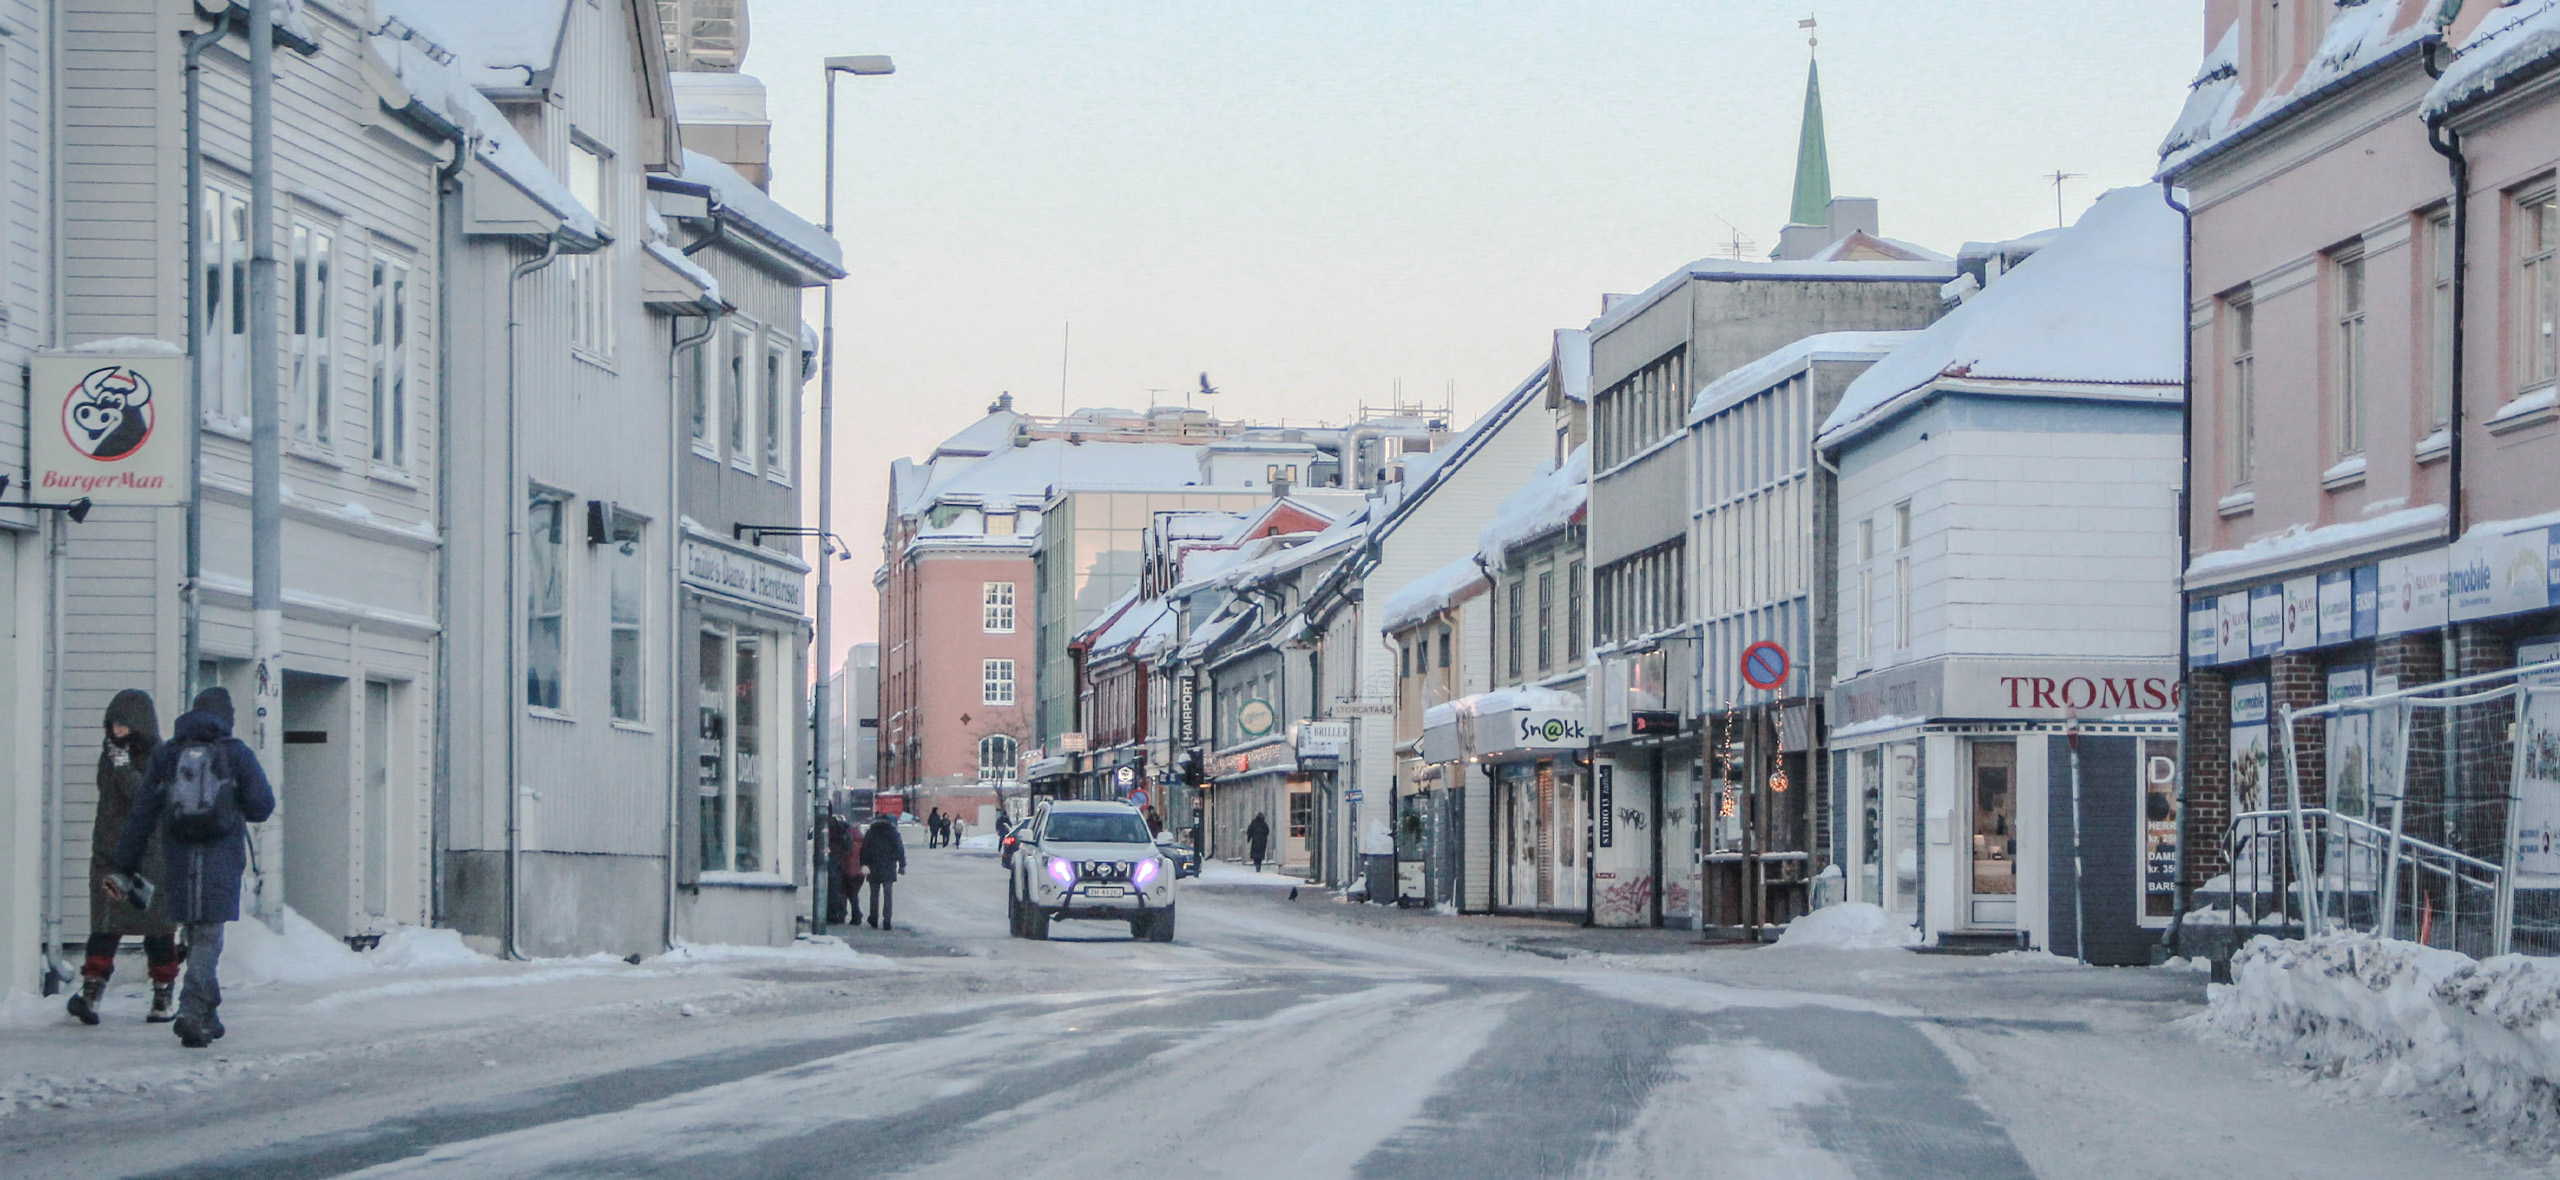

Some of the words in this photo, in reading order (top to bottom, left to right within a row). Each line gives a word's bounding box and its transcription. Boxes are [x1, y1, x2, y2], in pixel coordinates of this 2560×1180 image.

[42, 470, 164, 492] BurgerMan
[1182, 679, 1192, 741] HAIRPORT
[2233, 684, 2265, 713] Lycamobile
[1314, 726, 1348, 737] BRILLER
[1521, 716, 1584, 742] Sn@kk
[1601, 810, 1609, 844] STUDIO
